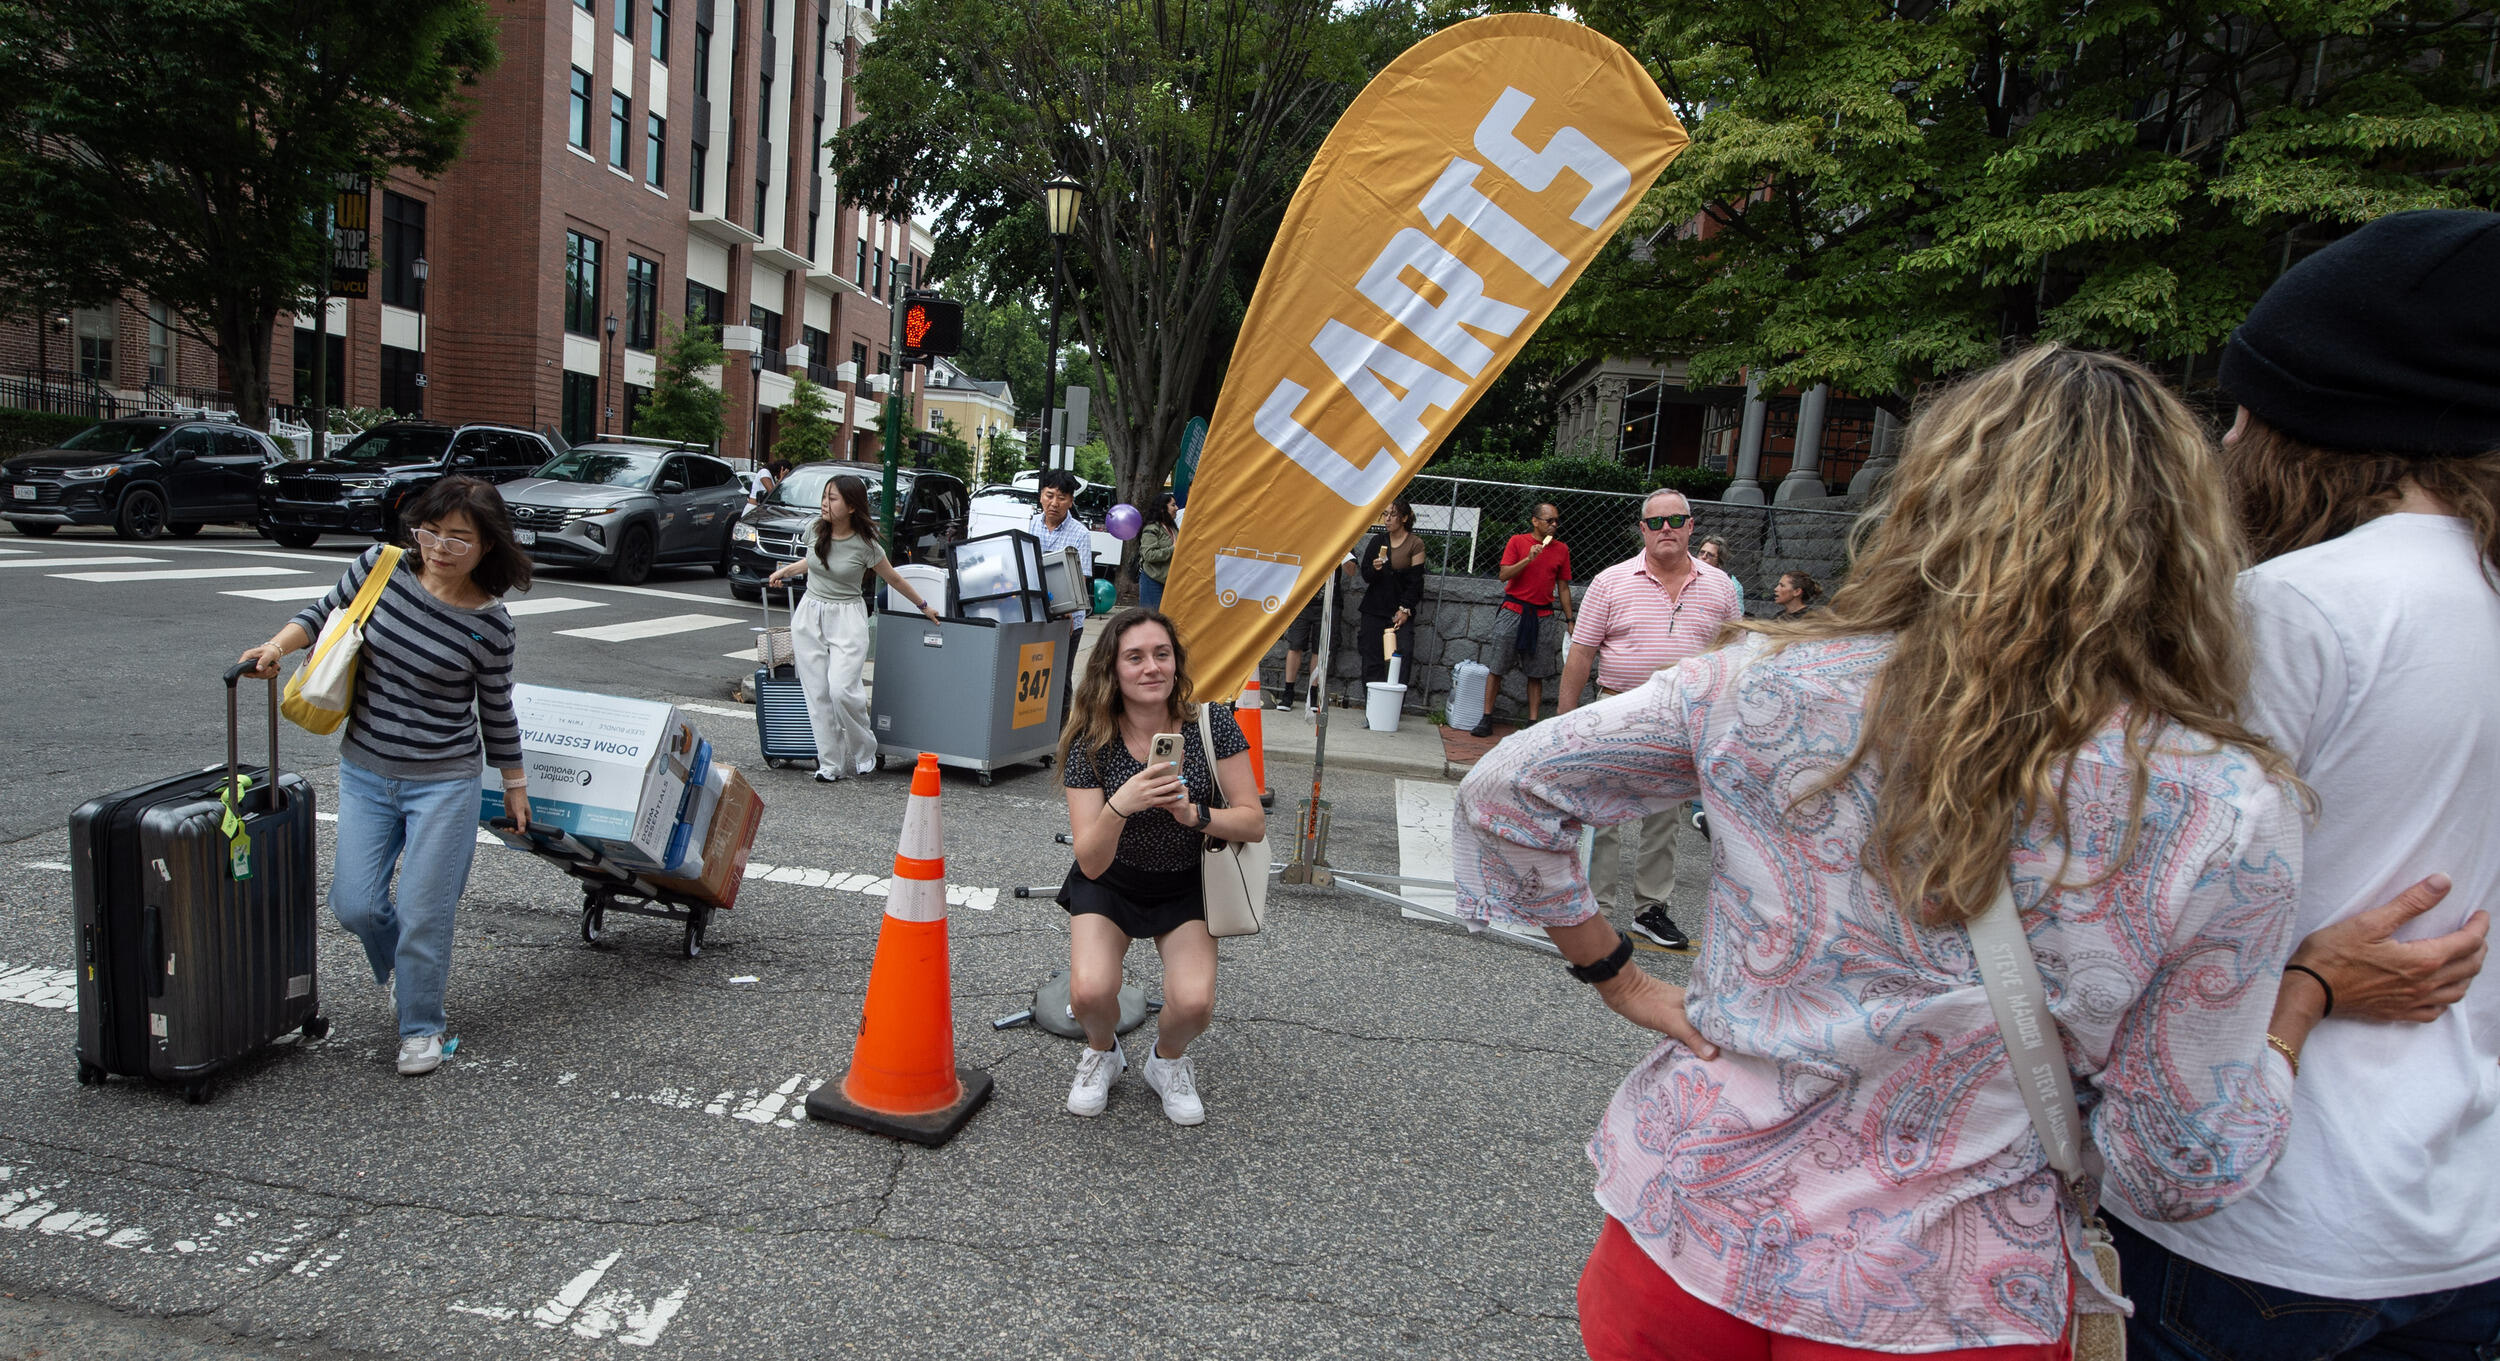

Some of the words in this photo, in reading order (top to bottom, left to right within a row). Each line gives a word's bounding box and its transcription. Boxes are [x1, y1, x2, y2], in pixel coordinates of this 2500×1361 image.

[338, 193, 367, 229] UN
[334, 227, 365, 250] STOP
[335, 250, 369, 270] PABLE
[343, 281, 367, 293] VCU
[1253, 85, 1632, 507] CARTS
[1018, 667, 1051, 702] 347
[519, 728, 591, 750] ESSENTIAL
[600, 723, 626, 734] BUNDLE
[594, 740, 639, 757] DORM
[533, 764, 576, 775] revolution
[540, 772, 575, 783] comfort
[641, 807, 656, 843] DORM
[645, 780, 669, 846] ESSENTIALS
[1992, 942, 2024, 988] STEVE
[2007, 993, 2045, 1051] MADDEN
[2031, 1063, 2059, 1103] STEVE
[2044, 1101, 2071, 1147] MADD
